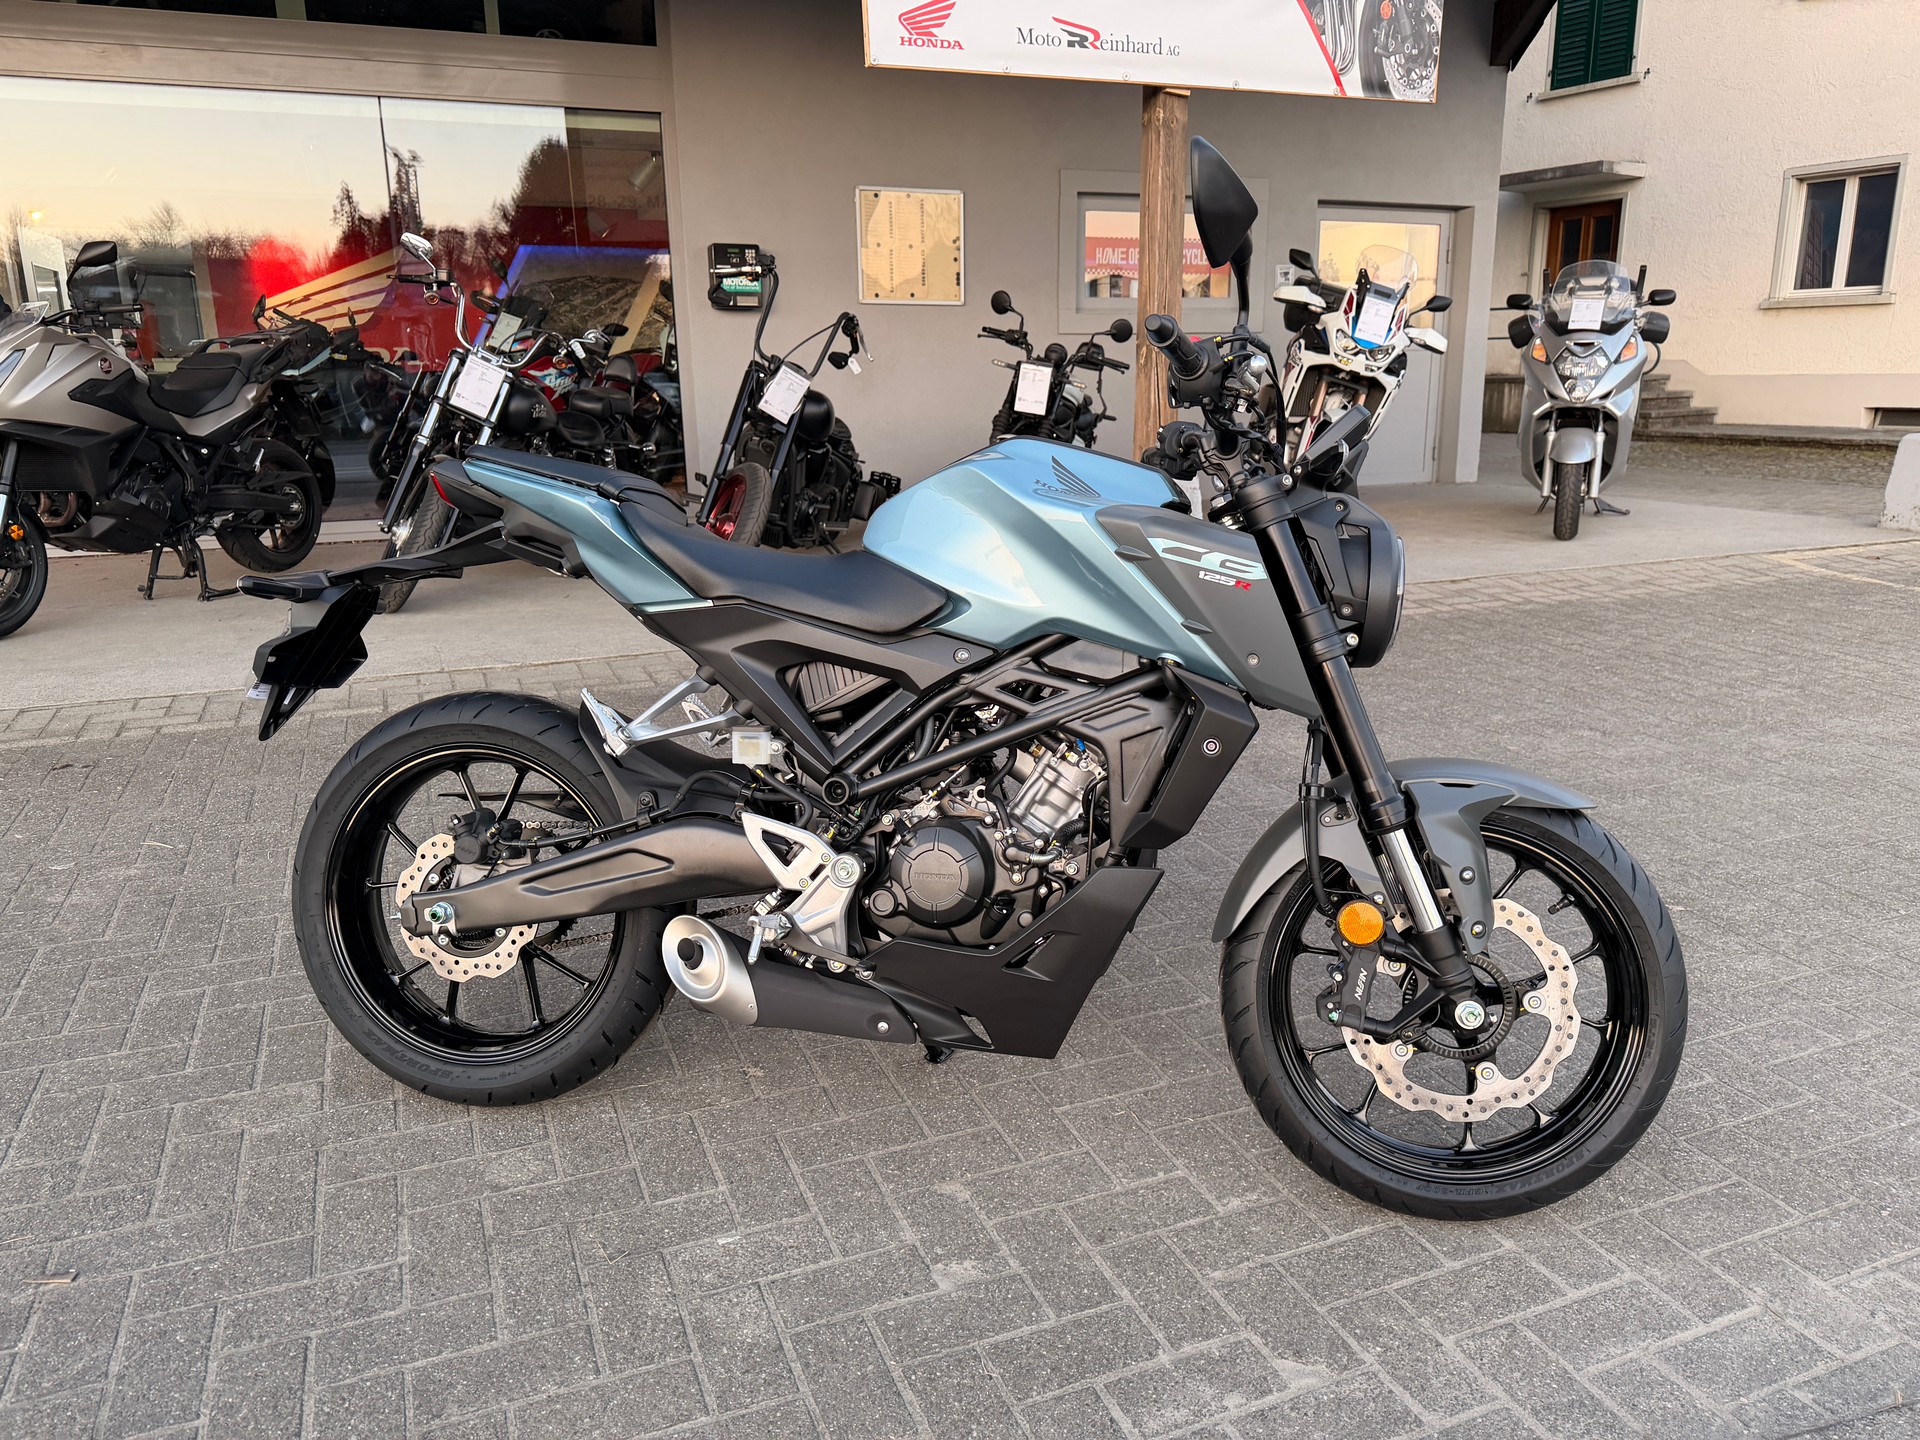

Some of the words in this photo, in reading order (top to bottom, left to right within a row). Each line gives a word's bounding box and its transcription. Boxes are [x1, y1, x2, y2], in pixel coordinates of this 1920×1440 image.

[899, 36, 965, 50] HONDA
[1016, 27, 1062, 47] Moto
[1166, 45, 1181, 56] AG
[1198, 570, 1252, 591] 125R
[913, 872, 957, 881] HONDA
